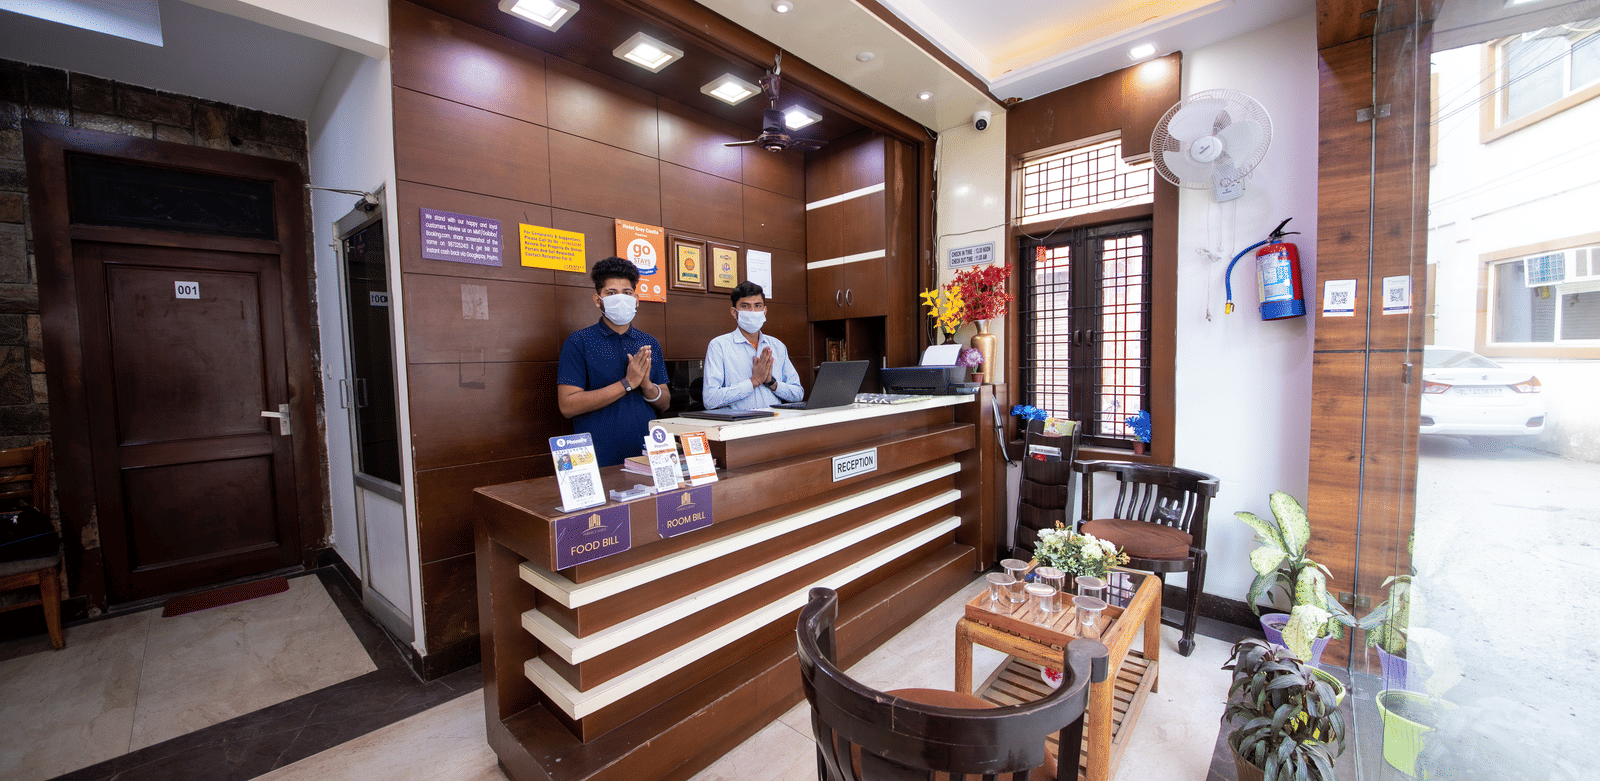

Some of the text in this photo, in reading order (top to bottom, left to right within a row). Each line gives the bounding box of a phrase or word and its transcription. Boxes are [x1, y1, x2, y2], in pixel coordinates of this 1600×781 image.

[466, 220, 478, 228] happy
[633, 244, 650, 257] go
[178, 286, 196, 294] 001
[838, 456, 873, 473] RECEPTION
[667, 512, 705, 528] ROOM BILL
[571, 536, 619, 556] FOOD BILL
